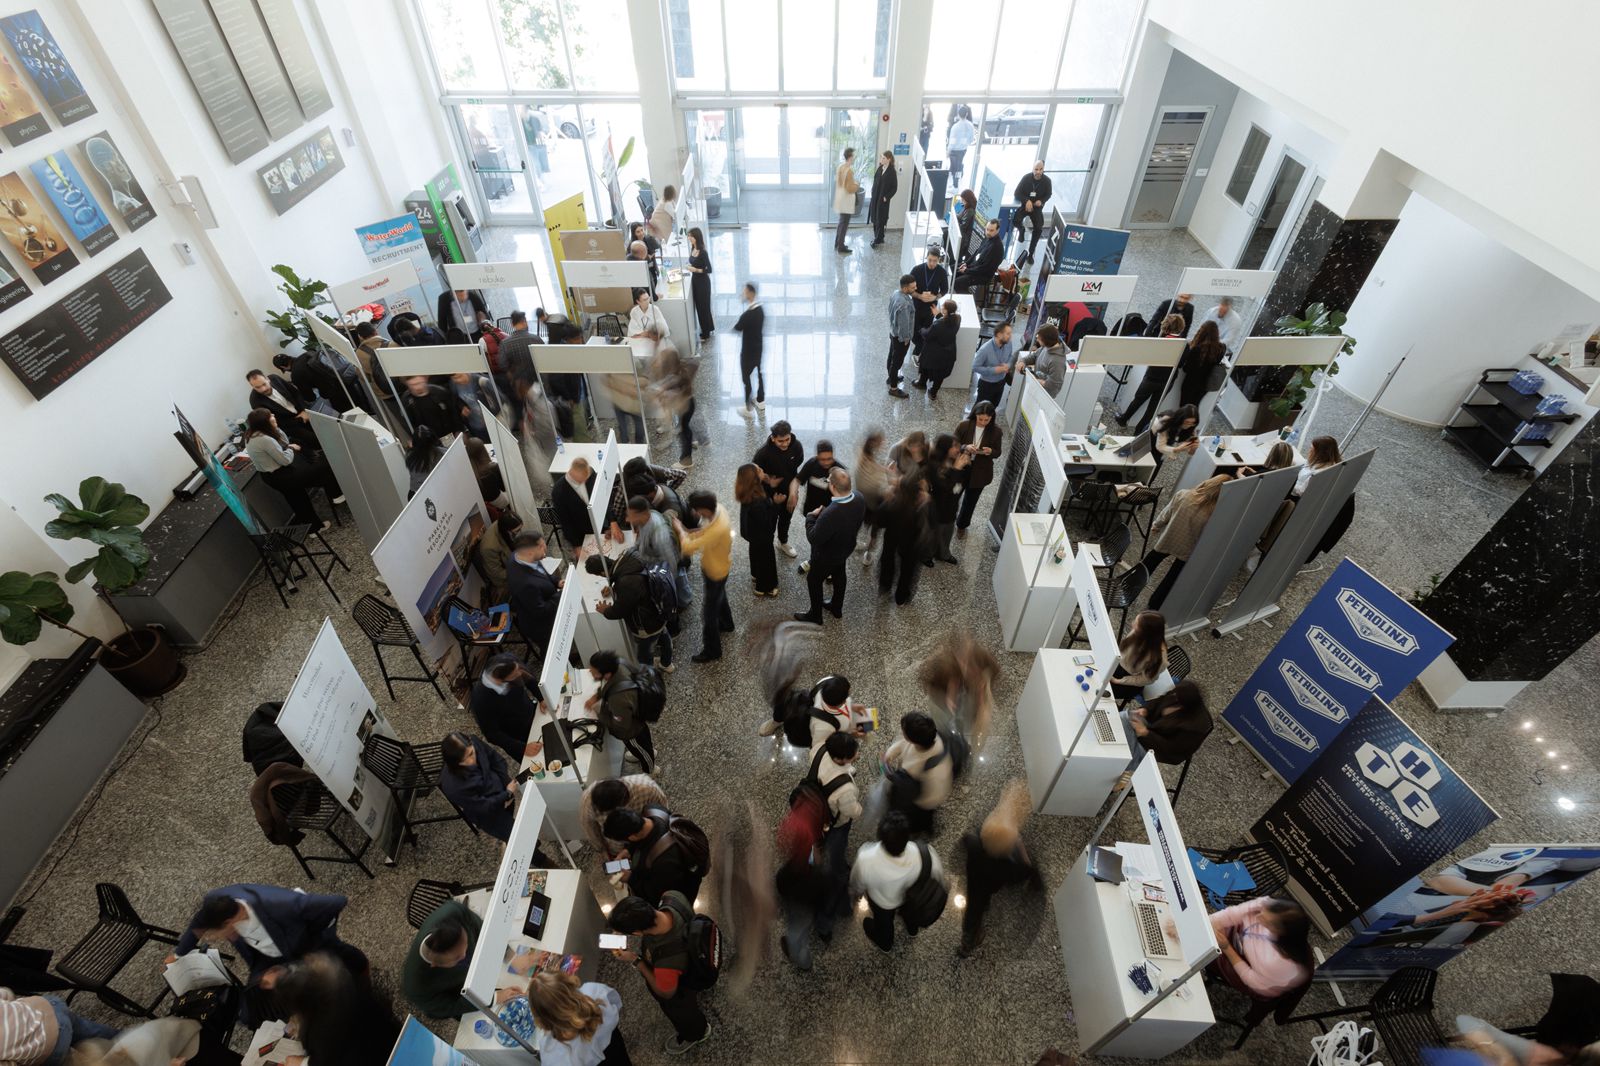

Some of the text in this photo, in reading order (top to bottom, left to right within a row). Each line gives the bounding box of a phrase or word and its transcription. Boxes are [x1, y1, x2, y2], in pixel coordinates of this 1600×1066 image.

[416, 208, 431, 220] 24
[366, 222, 413, 242] WaterWorld
[51, 262, 61, 271] law
[371, 243, 423, 263] RECRUITMENT
[1062, 256, 1078, 265] Taking
[0, 285, 26, 304] ngineering
[1081, 282, 1102, 292] LXM
[426, 530, 443, 554] RESORT
[427, 511, 447, 542] PARKLANE
[1344, 593, 1409, 647] PETROLINA
[1313, 631, 1373, 683] PETROLINA
[1285, 664, 1341, 715] PETROLINA
[1259, 695, 1312, 745] PETROLINA
[1399, 748, 1431, 780] H
[1342, 763, 1414, 838] HELLENIC TECHNICAL
[1363, 750, 1429, 819] T E
[1311, 788, 1337, 816] Information
[1318, 775, 1337, 796] Leading
[1350, 812, 1375, 835] company
[1326, 792, 1349, 816] following
[1339, 766, 1412, 840] ENTERPRISES LTD
[1159, 830, 1184, 902] HELLENIC TECHNICAL
[1262, 819, 1344, 913] Quality & Services
[1286, 826, 1361, 912] Technical Support
